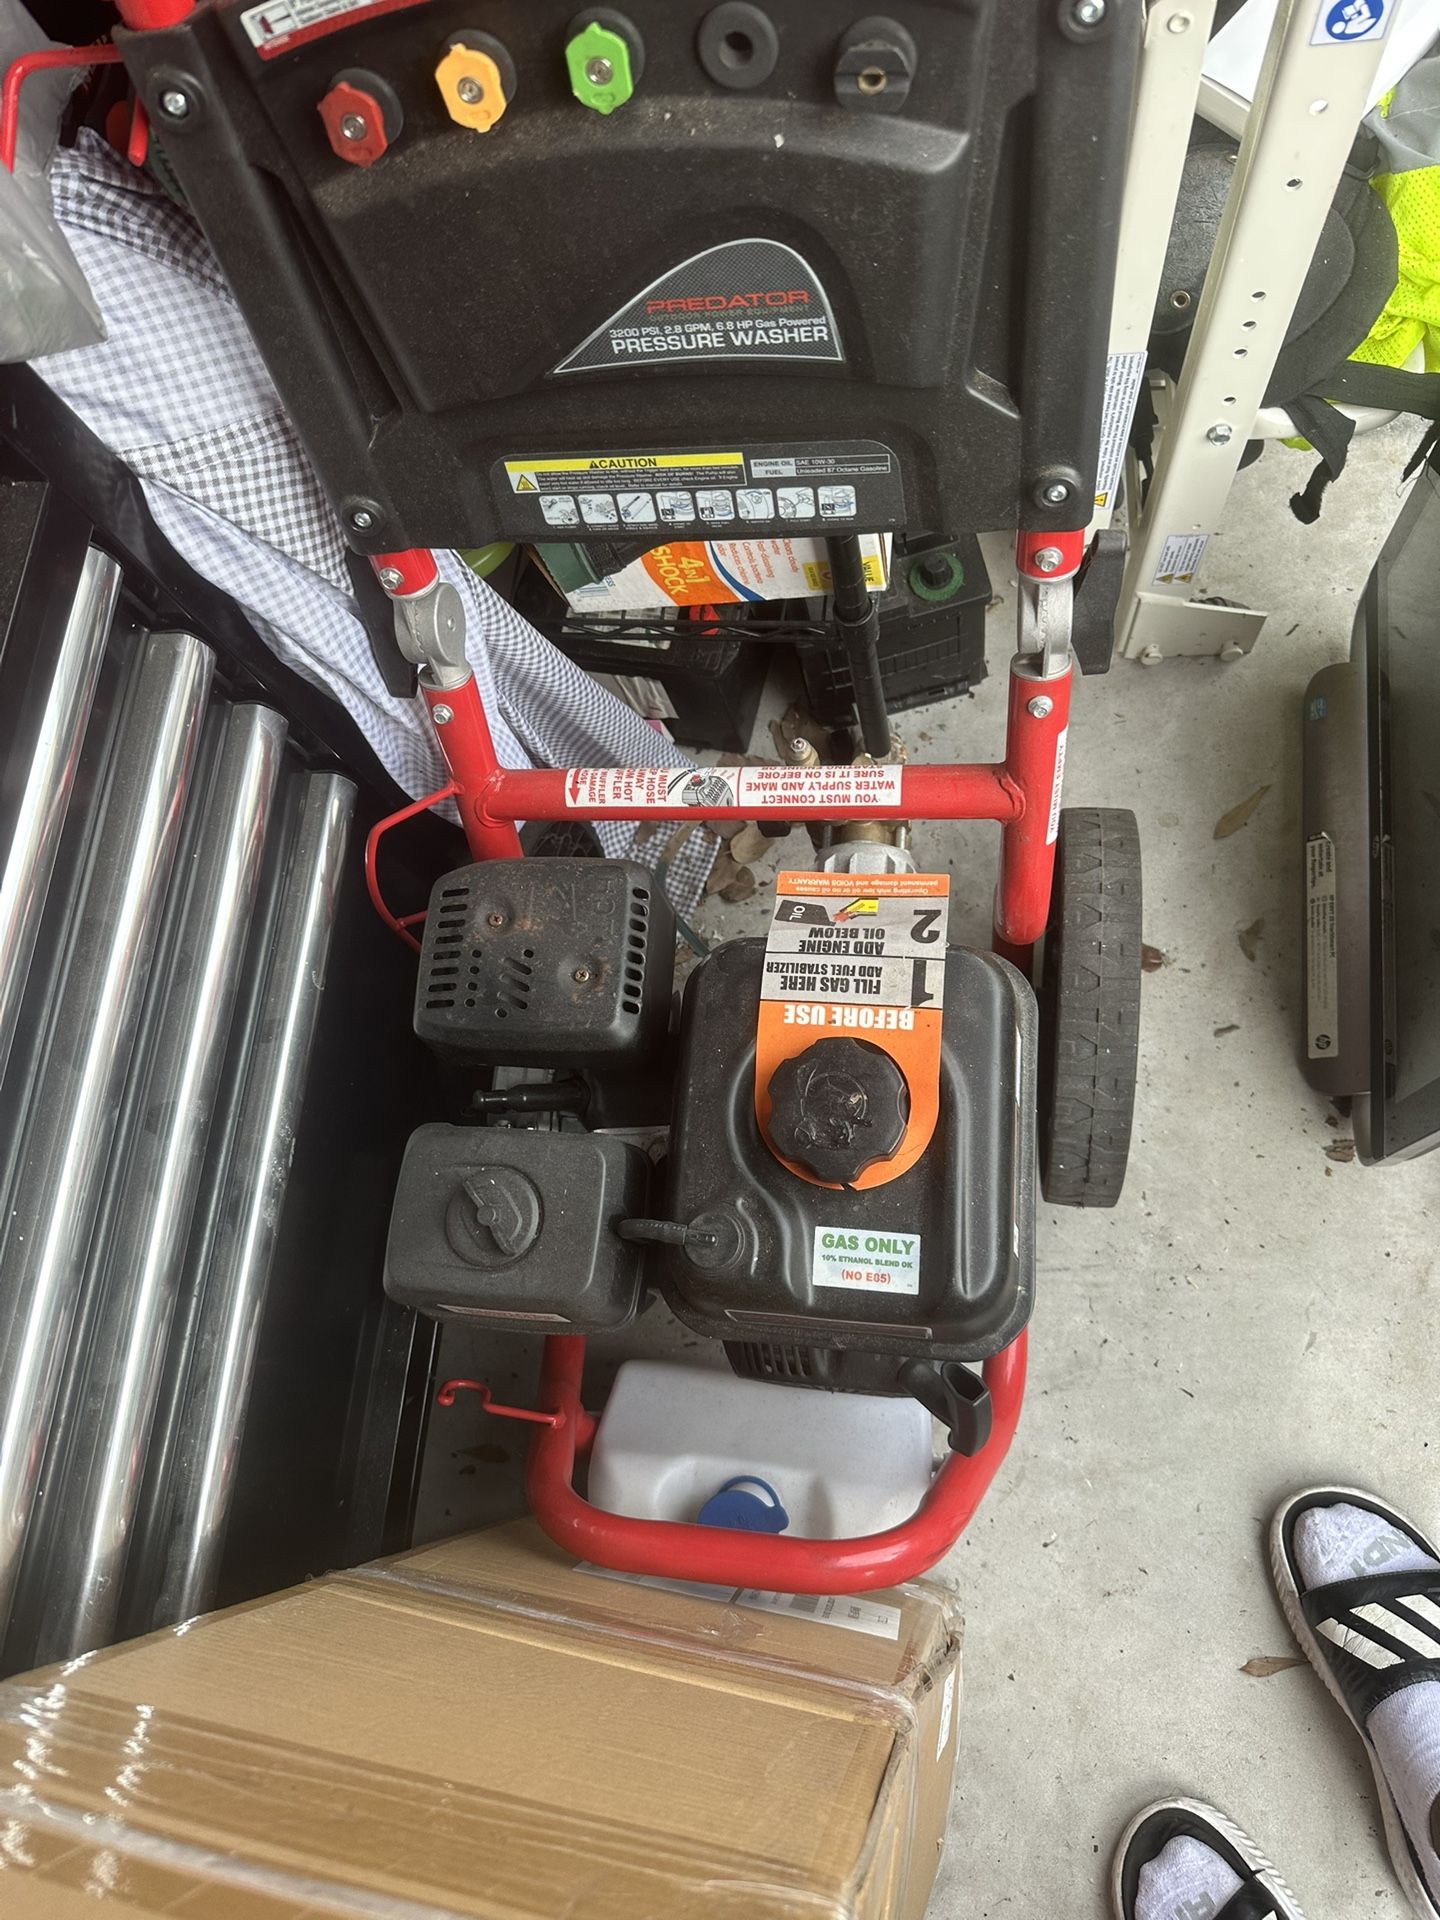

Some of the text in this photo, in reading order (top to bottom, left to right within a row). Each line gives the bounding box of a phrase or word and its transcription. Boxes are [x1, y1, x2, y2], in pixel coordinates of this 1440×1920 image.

[646, 290, 811, 314] PREDATOR
[609, 328, 640, 339] 3200
[664, 325, 682, 335] 2.8
[684, 323, 714, 334] GPM,
[716, 321, 734, 332] 6.8
[736, 320, 753, 330] HP
[755, 318, 777, 328] Gas
[779, 316, 827, 327] Powered
[611, 326, 830, 355] PRESSURE WASHER
[599, 457, 657, 469] CAUTION
[797, 467, 826, 475] Unleaded
[860, 465, 888, 473] Gasoline
[650, 546, 690, 595] SHOCK
[757, 771, 803, 779] BEFORE
[805, 771, 823, 779] ON
[854, 770, 884, 778] SURE
[624, 780, 633, 802] HOT
[646, 777, 656, 804] HOSE
[657, 774, 667, 802] MUST
[745, 781, 895, 792] WATER SUPPLY AND MAKE
[762, 794, 878, 804] YOU MUST CONNECT
[831, 878, 854, 886] VOIDS
[789, 904, 806, 921] OIL
[798, 909, 942, 955] 2 ADD ENGINE
[808, 927, 886, 940] OIL BELOW
[766, 961, 883, 978] ADD FUEL STABILIZER
[780, 959, 934, 1008] 1 FILL GAS HERE
[783, 1004, 915, 1030] BEFORE USE
[821, 1233, 915, 1256] GAS ONLY
[821, 1254, 913, 1269] 10% ETHANOL BLEND OK
[841, 1268, 863, 1281] (NO
